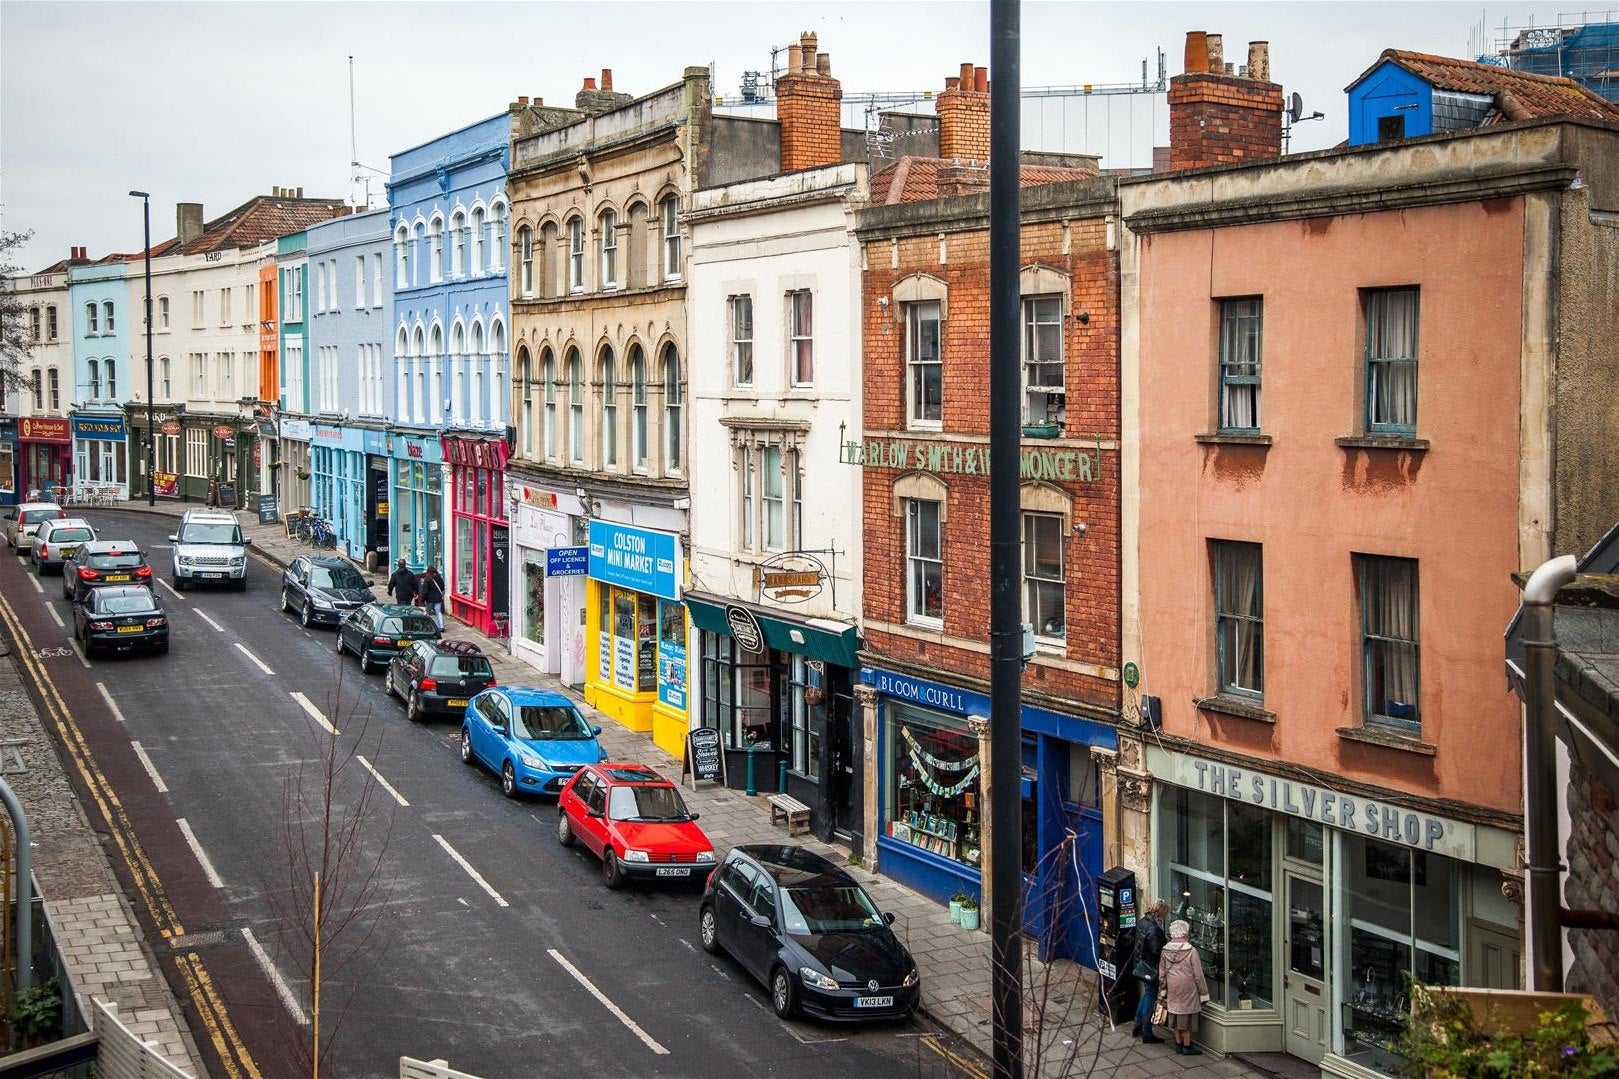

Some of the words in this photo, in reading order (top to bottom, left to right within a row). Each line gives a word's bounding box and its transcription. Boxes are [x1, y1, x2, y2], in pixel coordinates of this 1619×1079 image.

[204, 252, 222, 262] YARD
[144, 411, 166, 424] YRD
[846, 440, 909, 469] WARLOW
[965, 446, 977, 475] &
[614, 531, 646, 555] COLSTON
[558, 549, 578, 557] OPEN
[607, 548, 623, 568] MINI
[624, 551, 654, 575] MARKET
[881, 676, 919, 700] BLOOM
[919, 686, 927, 701] &
[926, 687, 964, 711] CURLL
[697, 763, 719, 773] WHISKEY
[1194, 760, 1242, 799] THE
[1251, 774, 1357, 830] SILVER
[1364, 802, 1445, 850] SHOP
[860, 998, 876, 1006] VK13
[877, 998, 891, 1006] LKN
